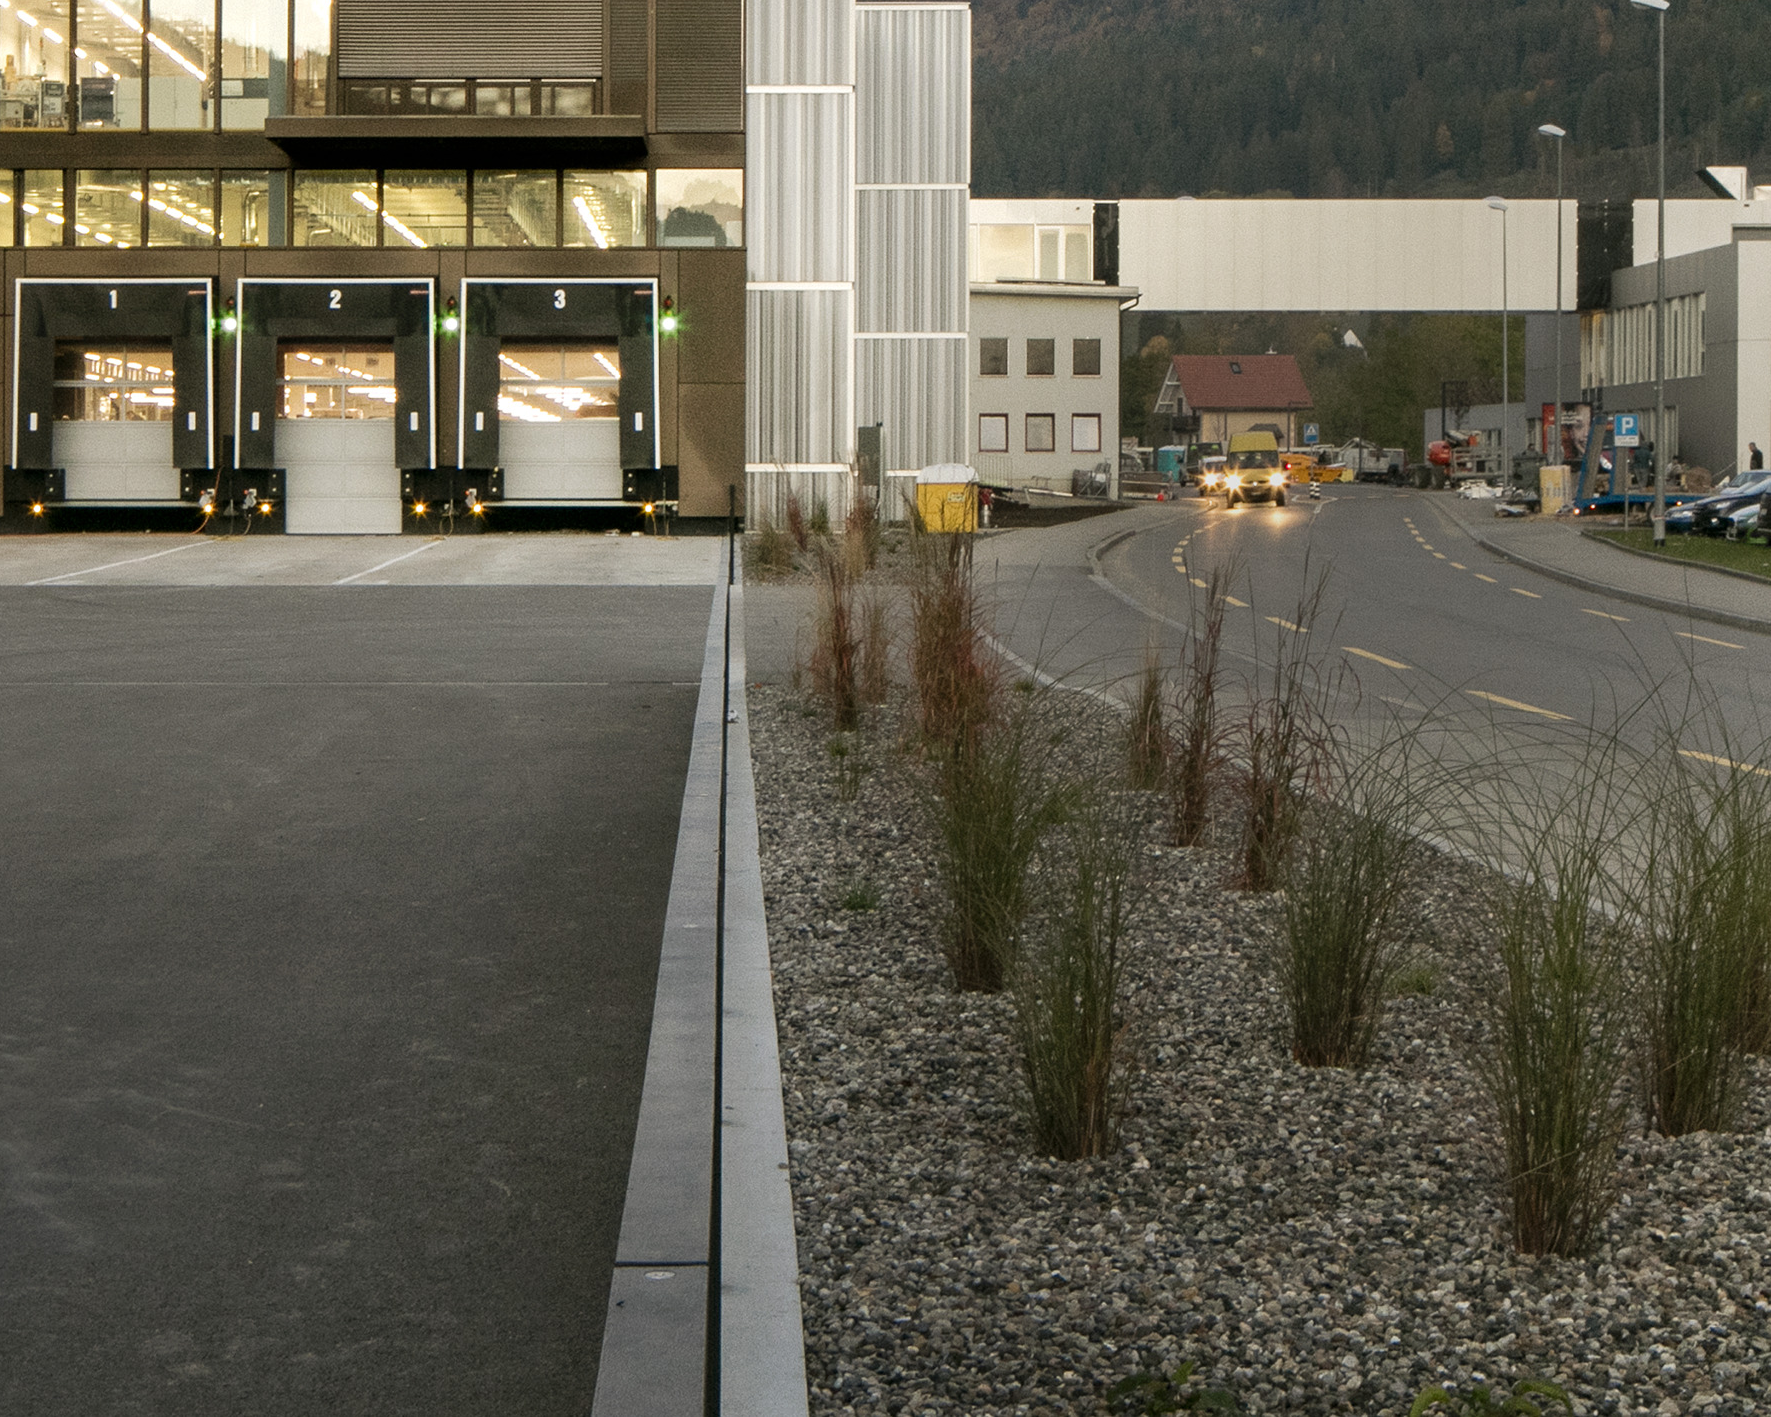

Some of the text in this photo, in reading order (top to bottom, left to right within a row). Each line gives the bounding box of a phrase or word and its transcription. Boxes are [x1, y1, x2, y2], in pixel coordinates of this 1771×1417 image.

[109, 289, 118, 309] 1
[329, 289, 342, 309] 2
[554, 288, 566, 309] 3
[1621, 417, 1634, 434] P
